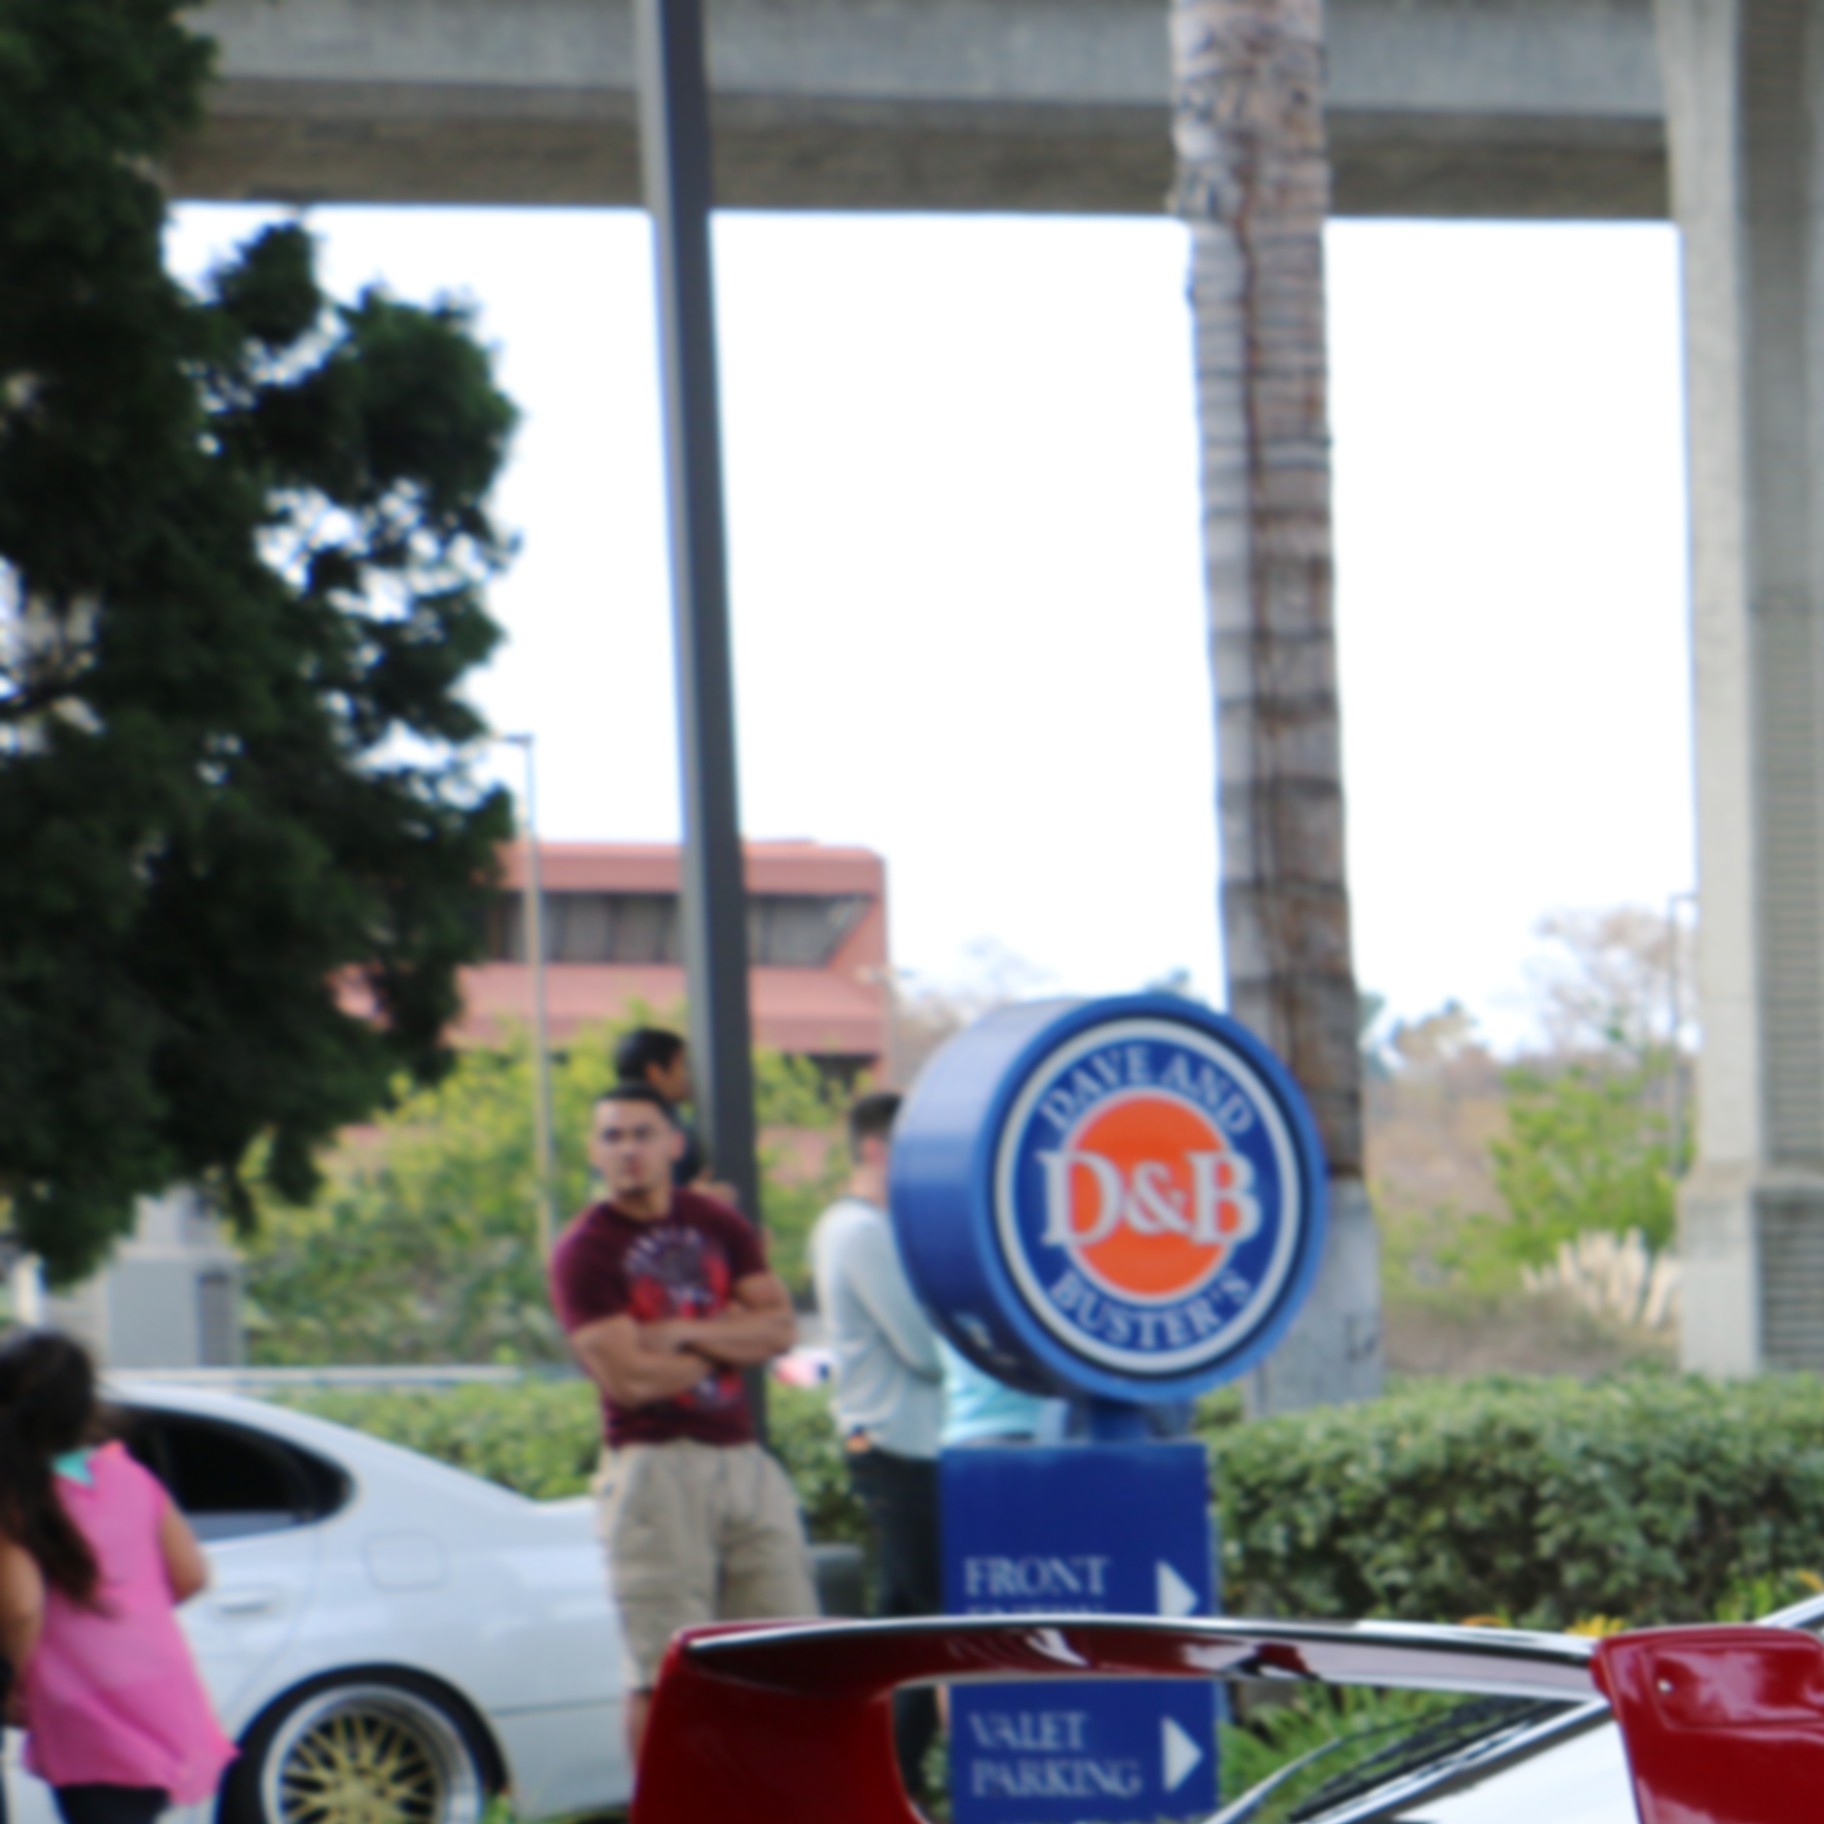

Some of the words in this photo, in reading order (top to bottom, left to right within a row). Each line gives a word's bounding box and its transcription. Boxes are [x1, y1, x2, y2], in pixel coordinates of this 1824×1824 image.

[1037, 1045, 1151, 1134] DAVE
[1162, 1052, 1254, 1135] AND
[1036, 1150, 1262, 1247] D&B
[1048, 1272, 1252, 1349] BUSTER'S
[964, 1556, 1111, 1597] FRONT
[967, 1711, 1089, 1750] VALET
[971, 1757, 1142, 1798] PARKING
